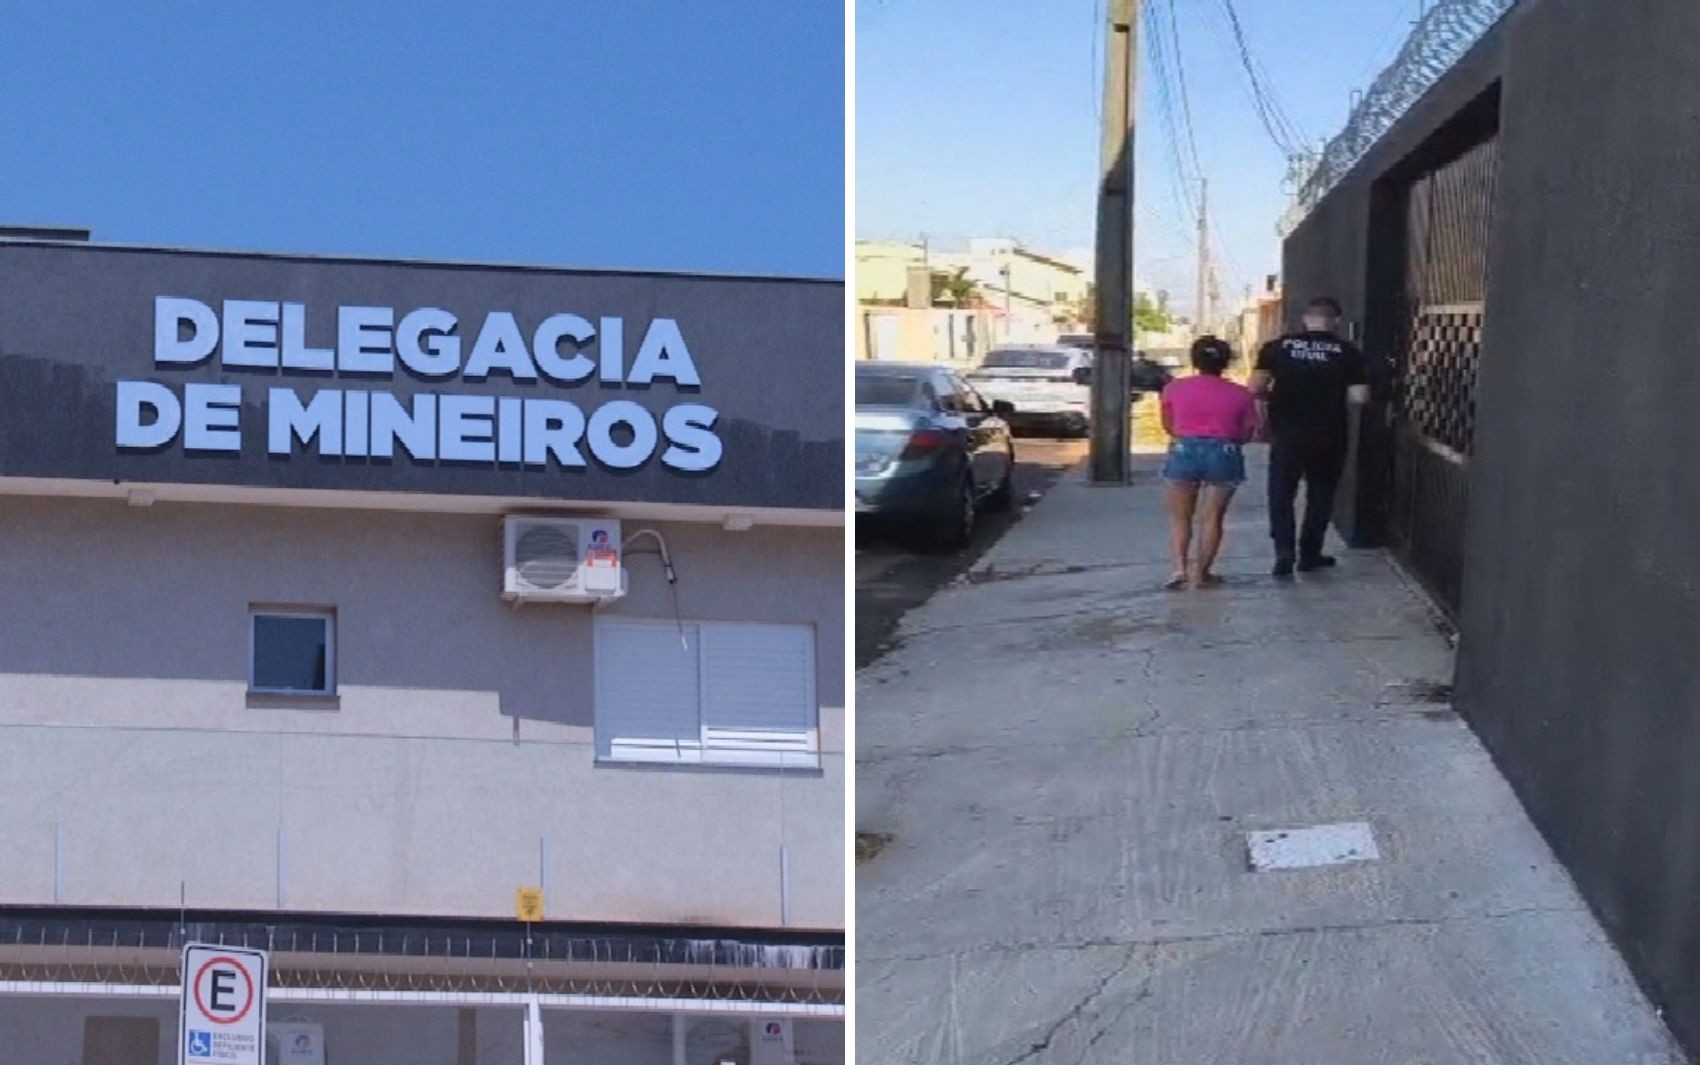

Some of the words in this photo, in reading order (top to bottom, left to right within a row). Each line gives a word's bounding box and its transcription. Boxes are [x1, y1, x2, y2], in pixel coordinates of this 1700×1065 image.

[154, 295, 702, 388] DELEGACIA
[115, 379, 242, 453] DE
[267, 386, 723, 472] MINEIROS
[210, 969, 237, 1012] E
